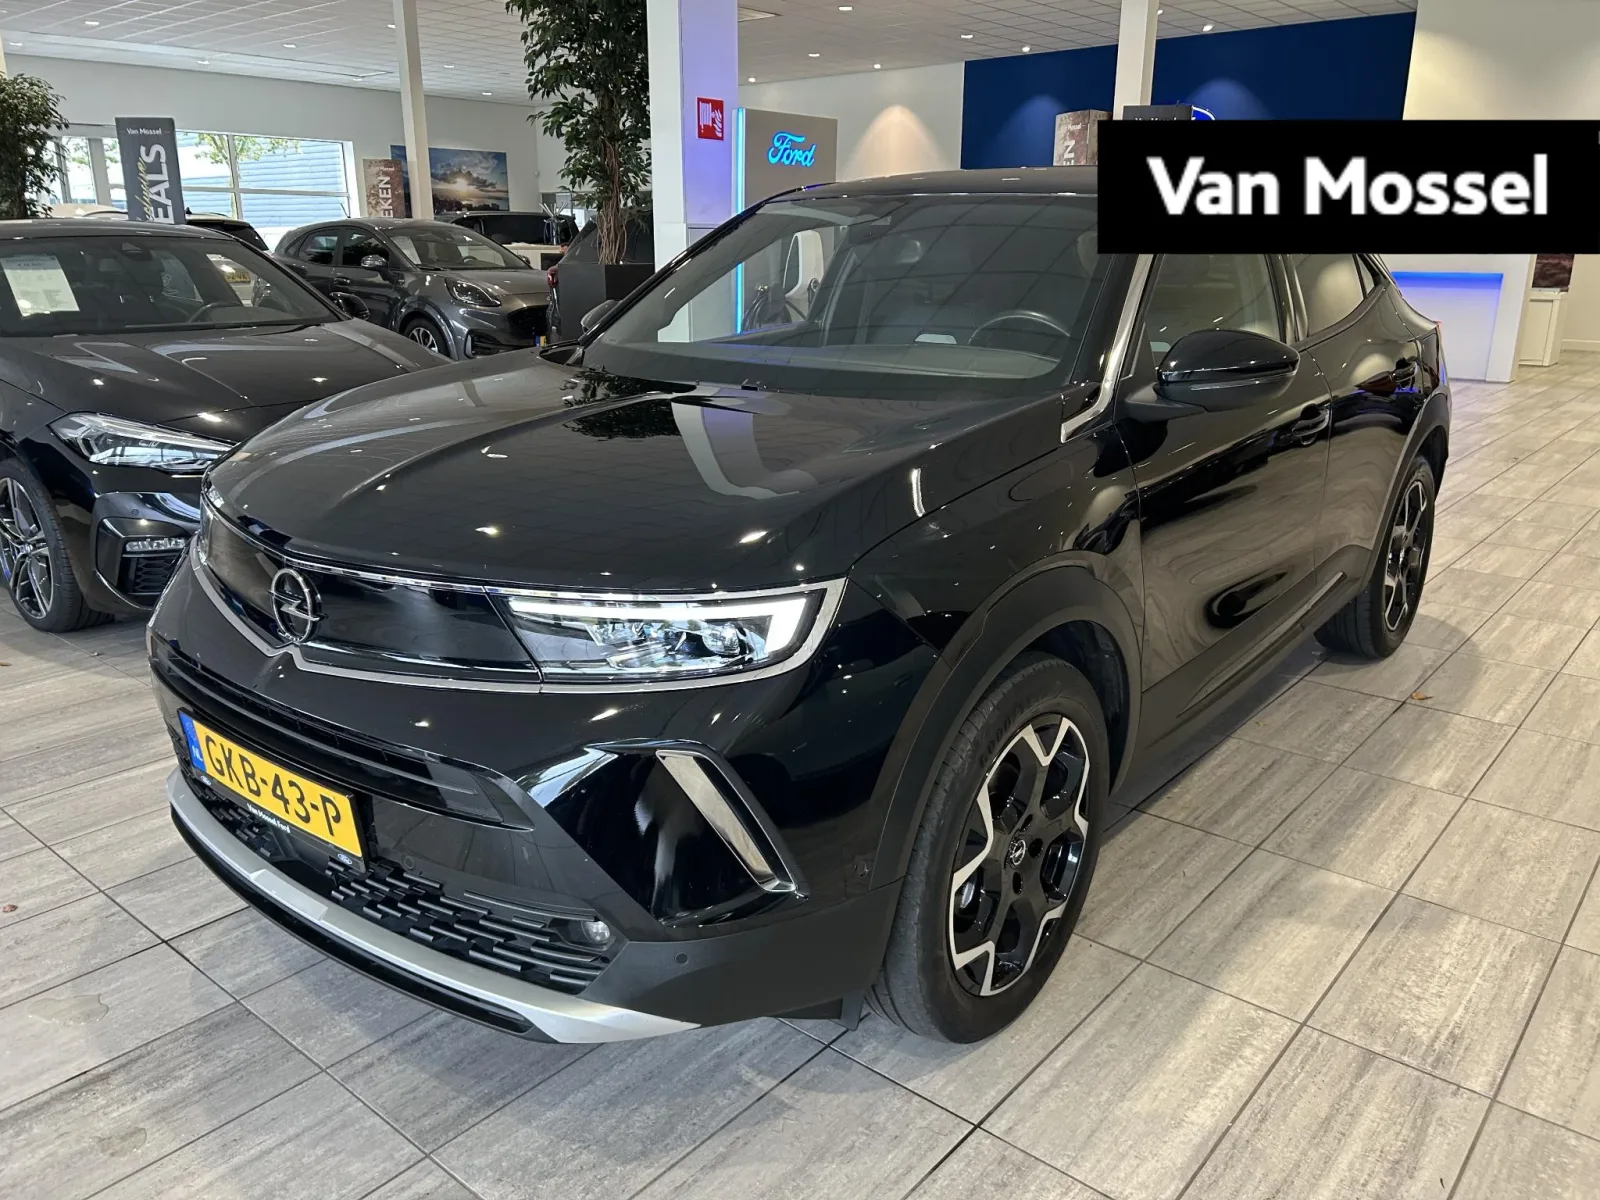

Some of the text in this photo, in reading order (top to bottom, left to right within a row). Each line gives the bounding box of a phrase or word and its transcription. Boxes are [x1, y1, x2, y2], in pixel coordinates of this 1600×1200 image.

[139, 127, 163, 135] Mossel
[767, 131, 817, 168] Ford
[192, 745, 204, 762] NL
[205, 734, 341, 837] GKB-43-P
